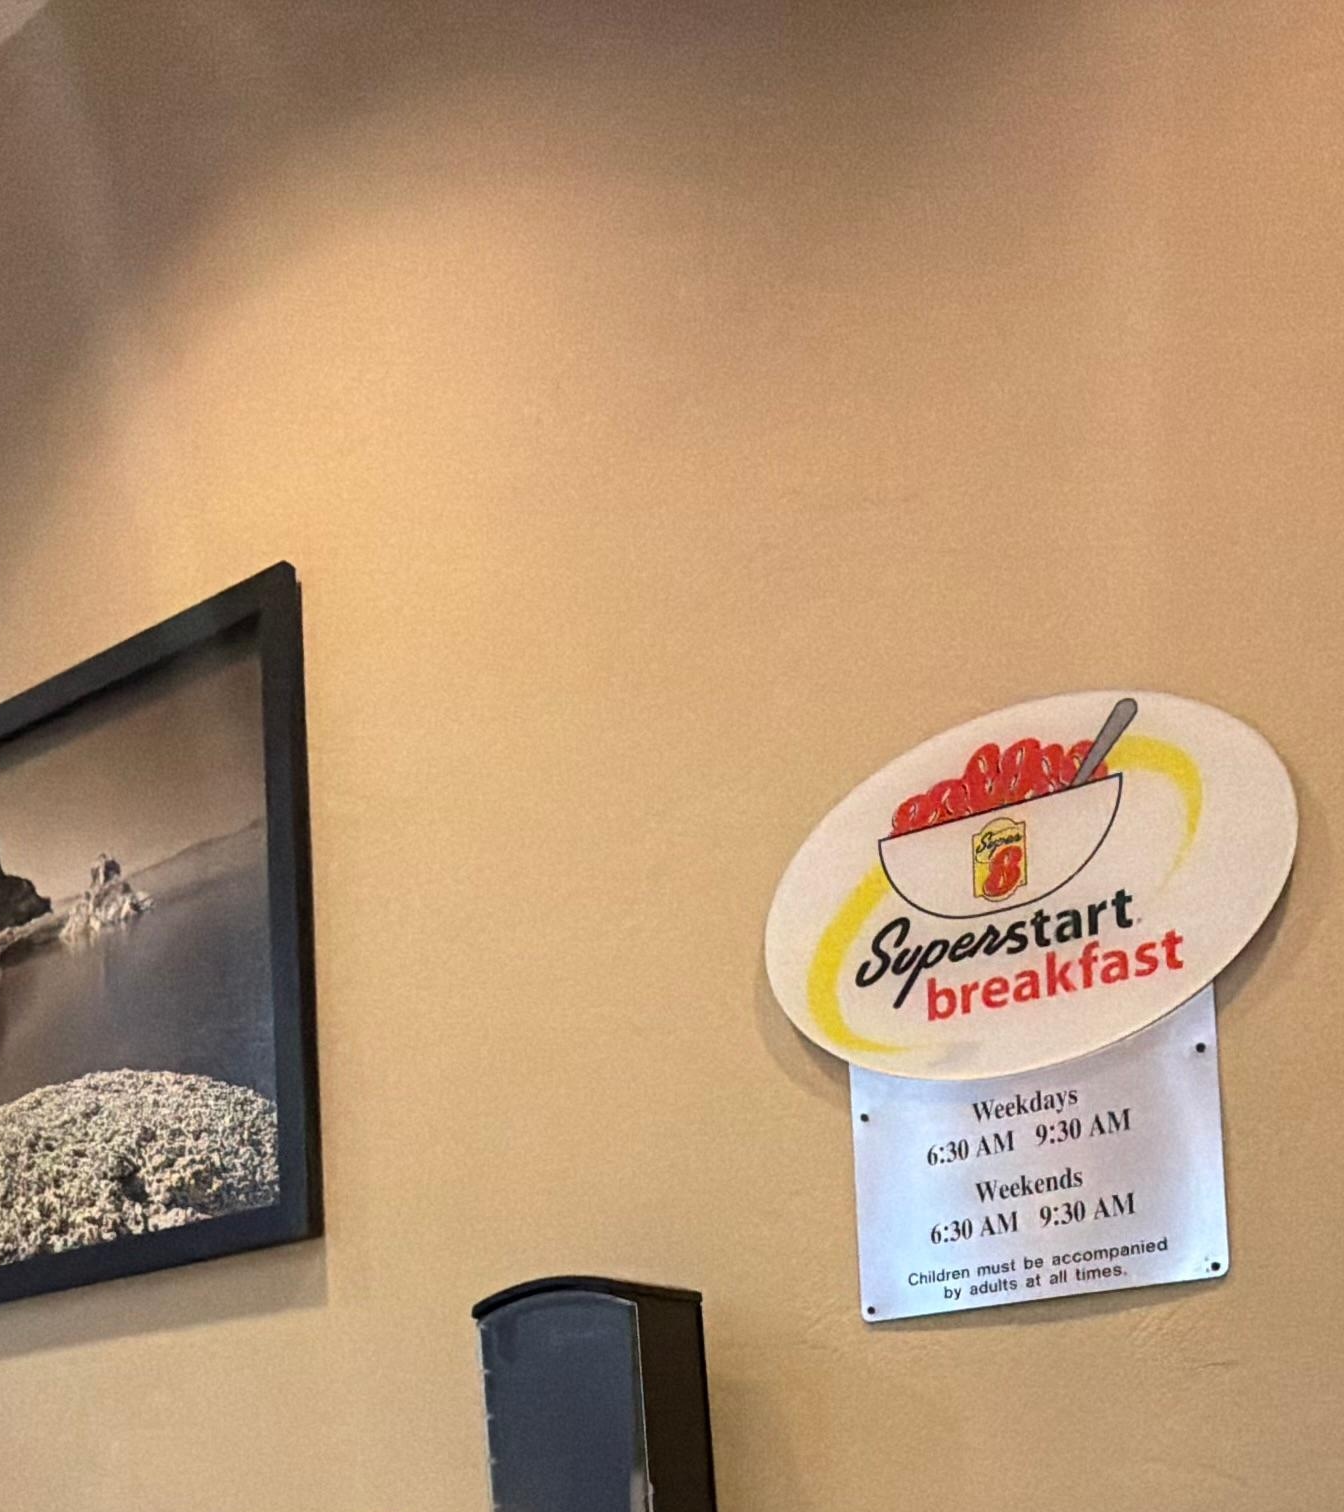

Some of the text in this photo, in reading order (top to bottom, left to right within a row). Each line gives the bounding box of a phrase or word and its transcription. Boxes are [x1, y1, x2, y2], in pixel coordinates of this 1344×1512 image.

[983, 845, 1023, 898] 8
[855, 888, 1134, 1009] Superstart
[927, 929, 1185, 1022] breakfast
[972, 1089, 1078, 1123] Weekdays
[927, 1108, 1131, 1166] 6:30 AM 9:30 AM
[975, 1167, 1084, 1203] Weekends
[930, 1192, 1136, 1245] 6:30 AM 9:30 AM
[907, 1236, 1169, 1286] Children must be accompanied
[944, 1266, 1128, 1300] by adults at all times.
